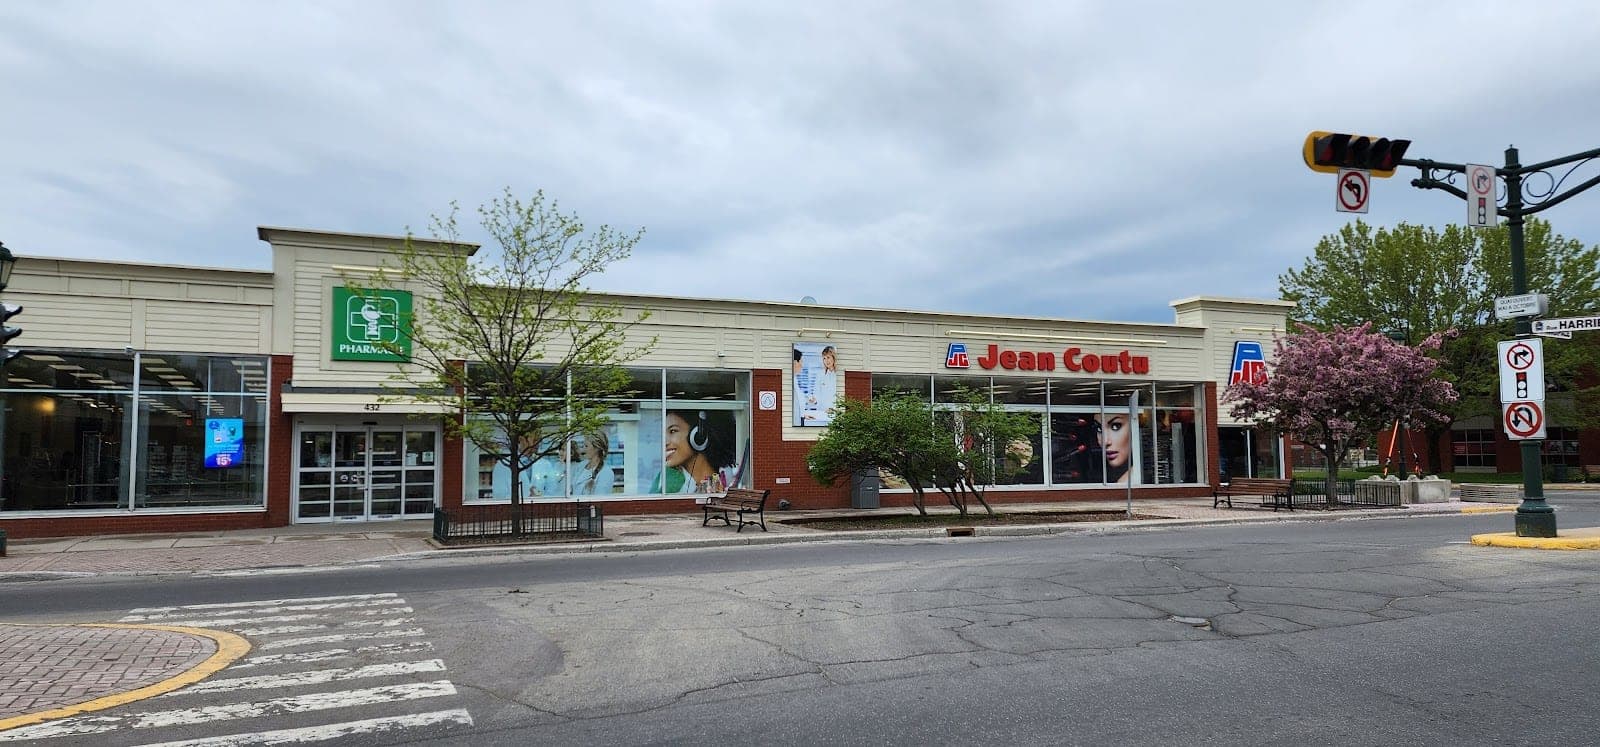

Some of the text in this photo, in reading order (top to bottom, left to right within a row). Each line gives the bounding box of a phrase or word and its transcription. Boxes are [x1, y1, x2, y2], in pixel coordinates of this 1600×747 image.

[340, 344, 404, 355] PHARMAE
[977, 344, 1149, 373] Jean Coutu
[364, 403, 380, 411] 432
